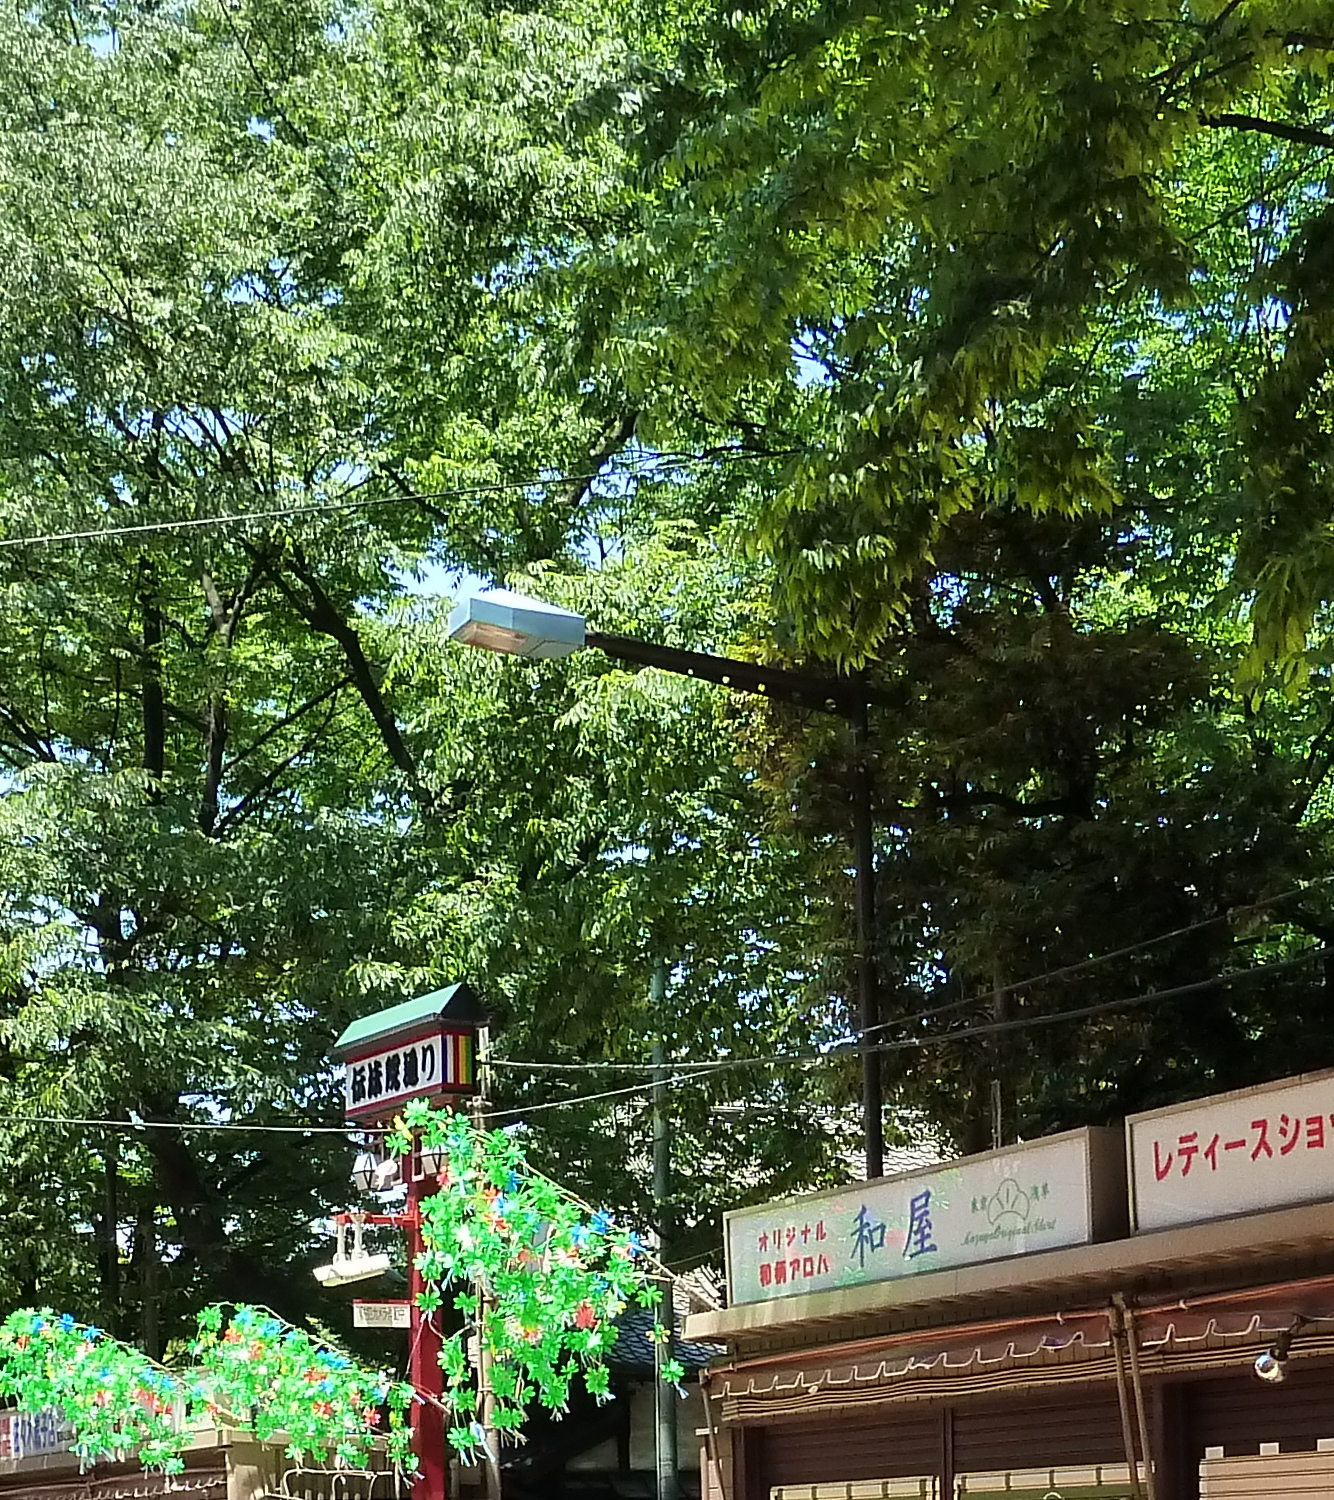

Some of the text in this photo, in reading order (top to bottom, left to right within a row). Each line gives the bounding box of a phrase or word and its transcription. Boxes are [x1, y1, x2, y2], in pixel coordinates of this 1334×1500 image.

[759, 1219, 827, 1252] オリジナル
[850, 1189, 937, 1268] 和屋
